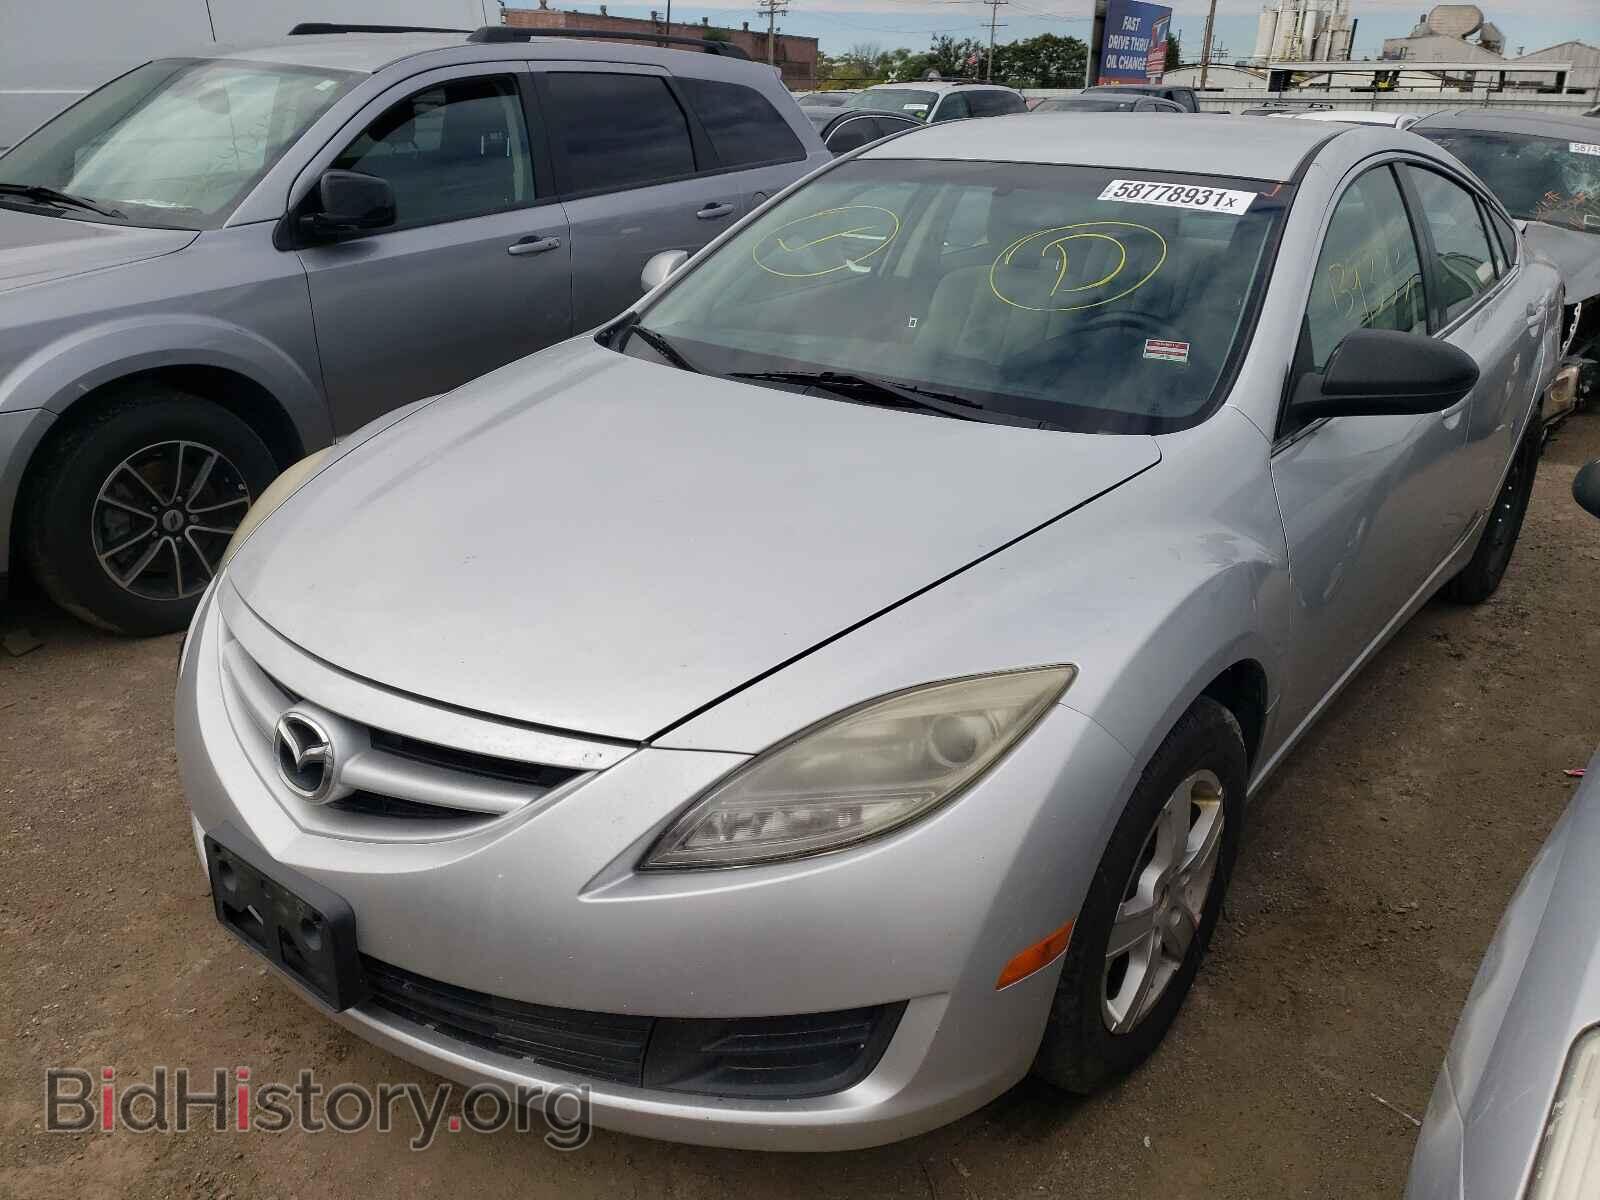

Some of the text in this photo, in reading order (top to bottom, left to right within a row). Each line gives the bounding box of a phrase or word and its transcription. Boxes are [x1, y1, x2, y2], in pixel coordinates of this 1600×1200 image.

[1122, 16, 1142, 31] FAST
[1108, 34, 1149, 51] DRIVE THRU
[1106, 54, 1147, 71] OIL CHANGE
